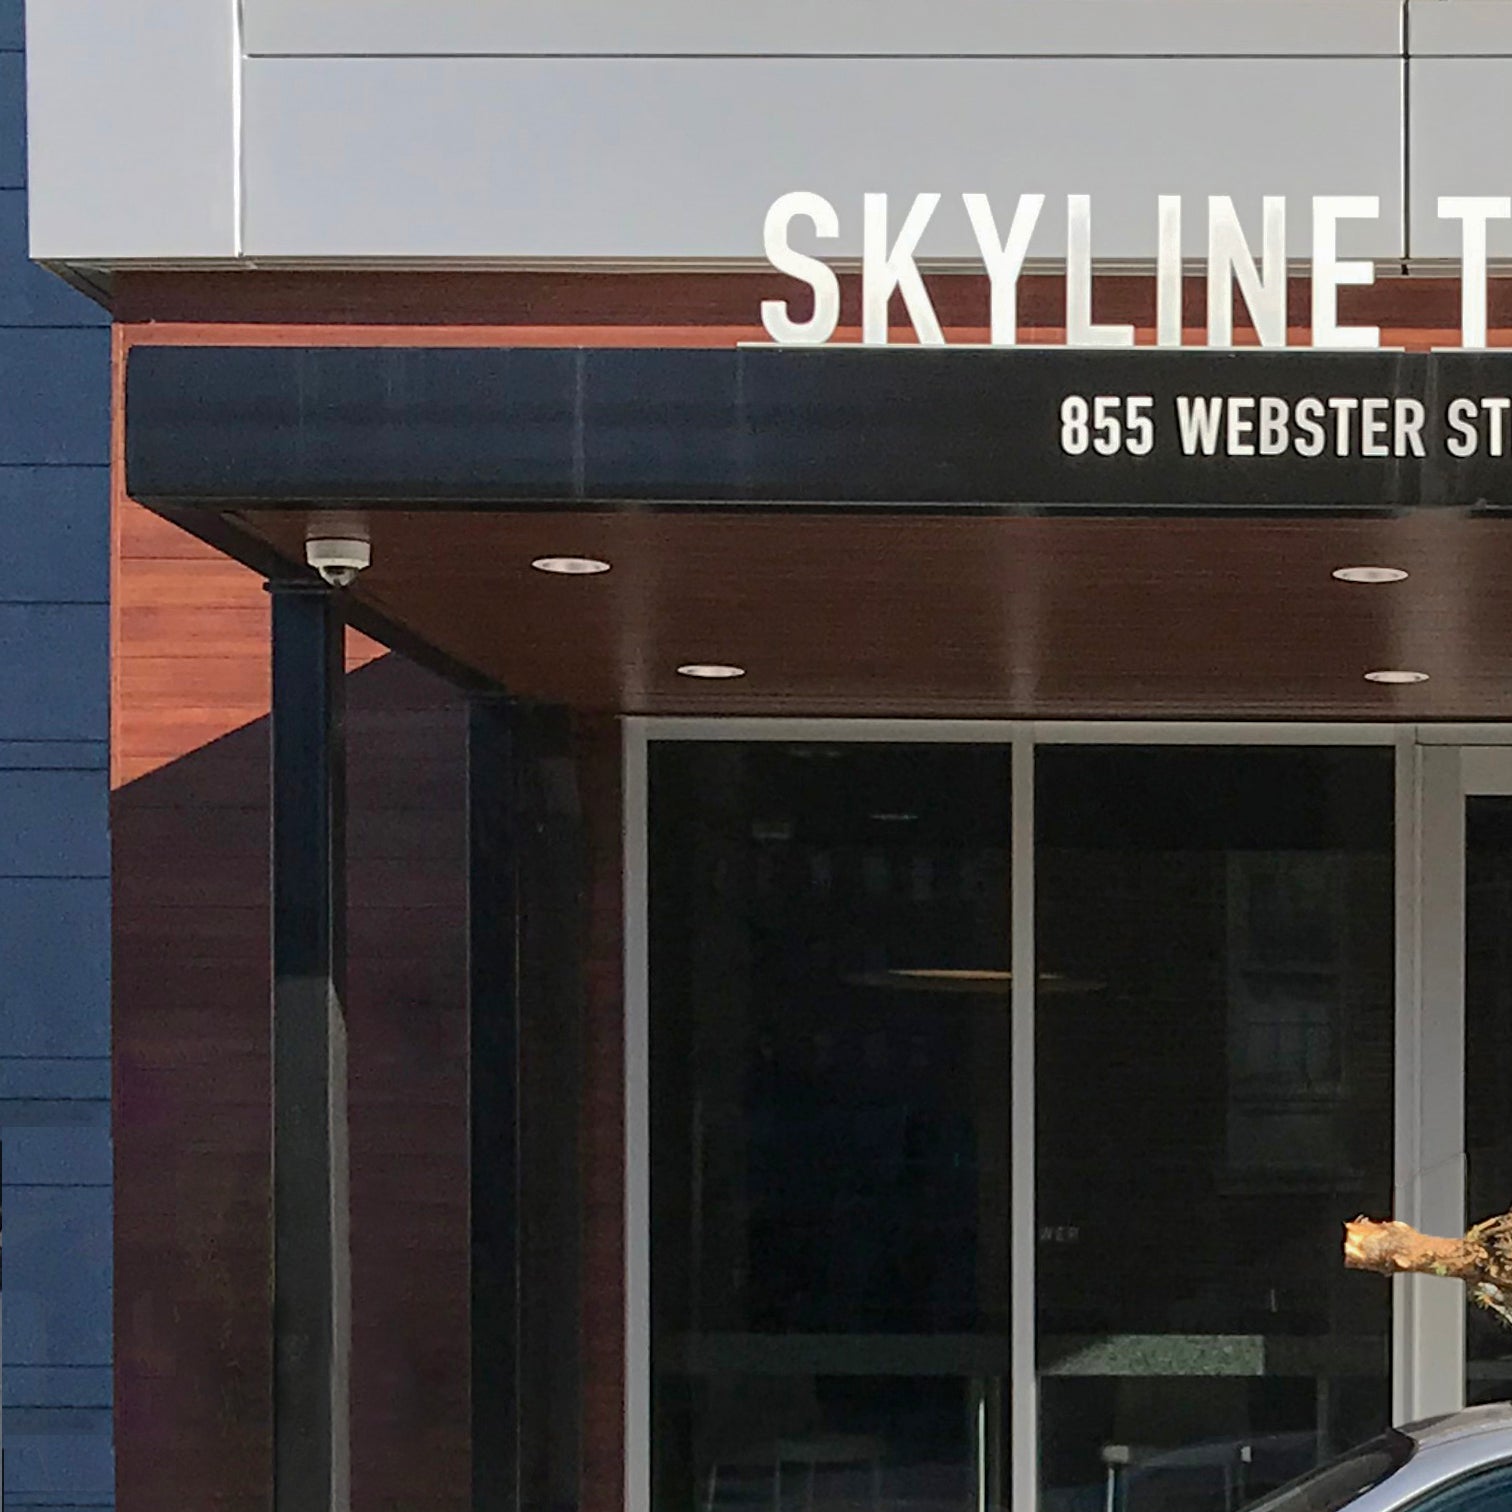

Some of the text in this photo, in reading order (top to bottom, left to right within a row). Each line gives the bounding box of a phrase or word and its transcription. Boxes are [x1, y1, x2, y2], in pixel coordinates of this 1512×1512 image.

[760, 190, 1381, 348] SKYLINE
[1060, 395, 1154, 457] 855
[1175, 396, 1427, 458] WEBSTER
